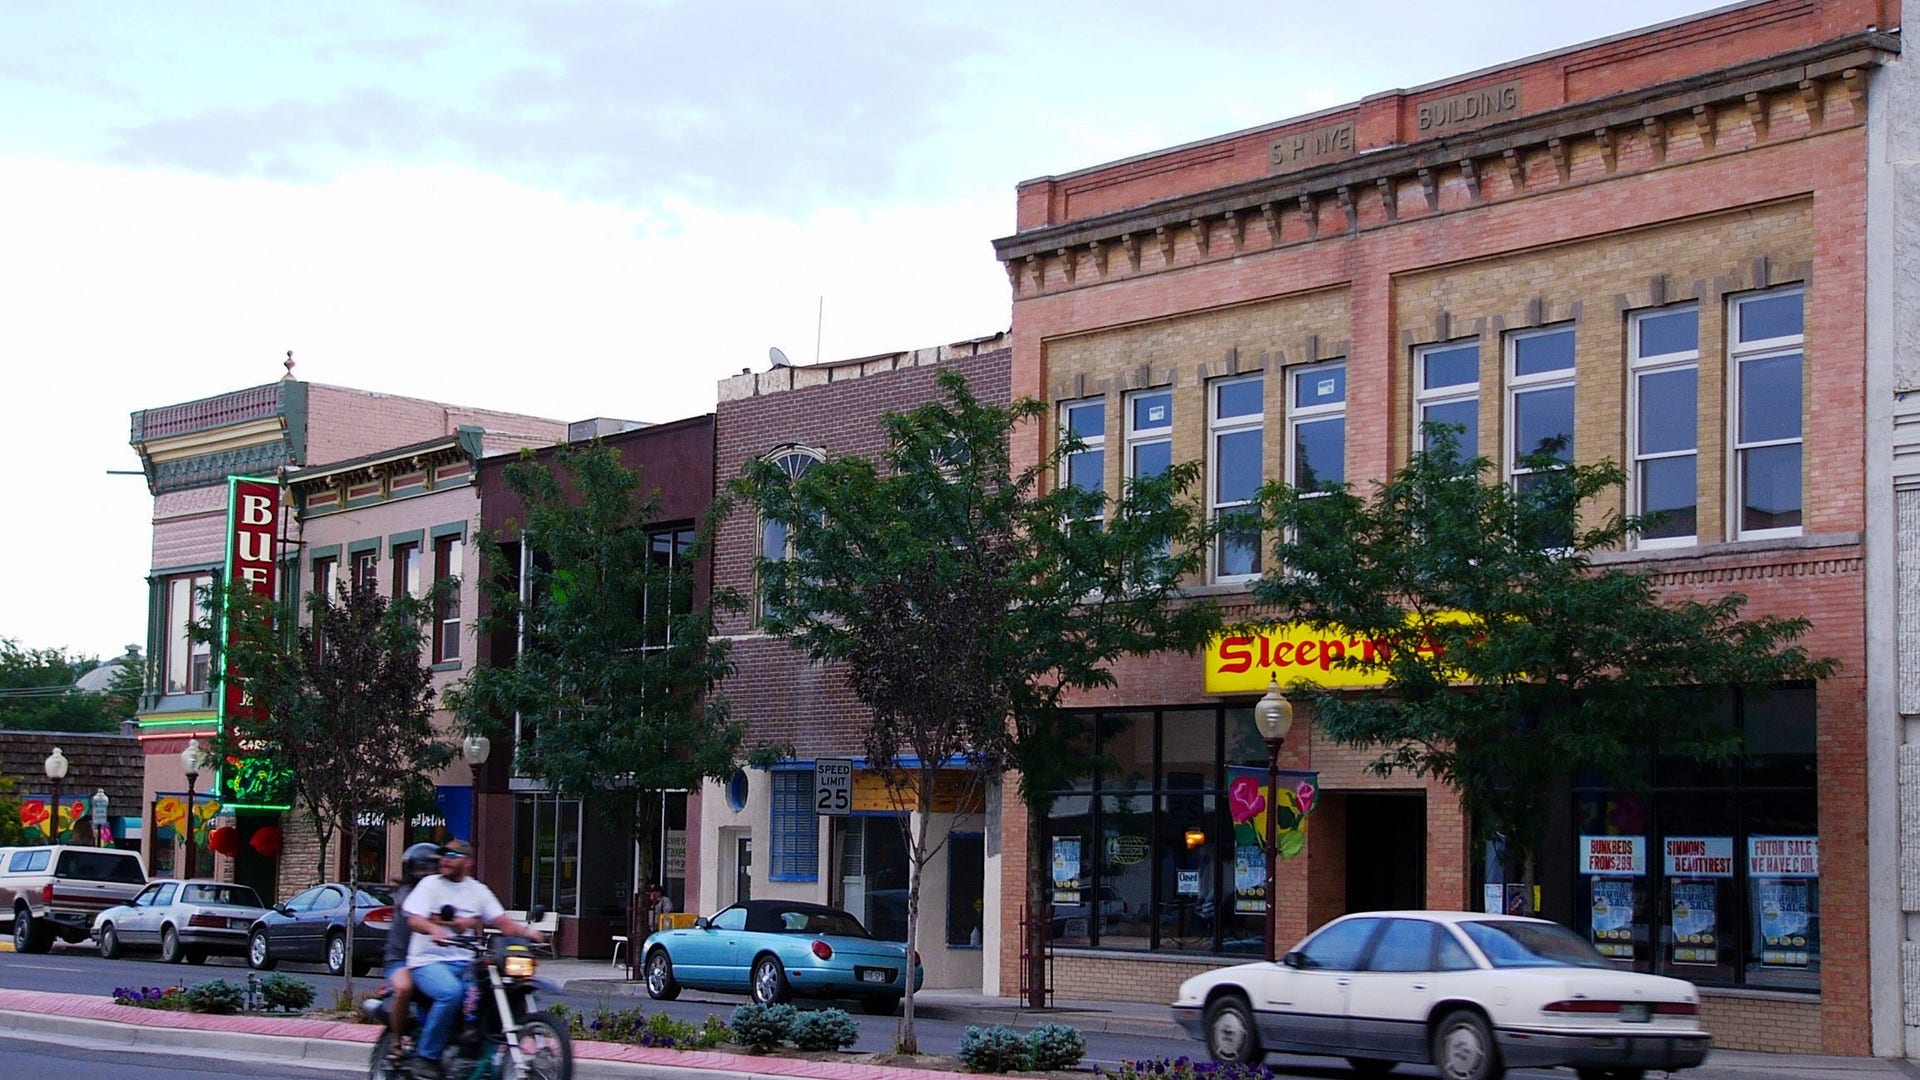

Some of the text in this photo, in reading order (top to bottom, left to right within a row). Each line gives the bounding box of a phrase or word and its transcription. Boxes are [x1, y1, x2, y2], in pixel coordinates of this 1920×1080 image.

[1418, 87, 1517, 130] BUILDING
[1270, 127, 1351, 166] S H NYE
[817, 764, 850, 775] SPEED
[821, 776, 846, 786] LIMIT
[817, 788, 849, 809] 25
[1666, 841, 1706, 856] SIMMONS
[1754, 841, 1812, 856] FUTON SALE
[1675, 857, 1732, 873] BEAUTYREST
[1751, 857, 1765, 872] WE
[1766, 857, 1791, 873] HAVE
[1689, 901, 1713, 910] SALE
[1780, 903, 1806, 912] SALE
